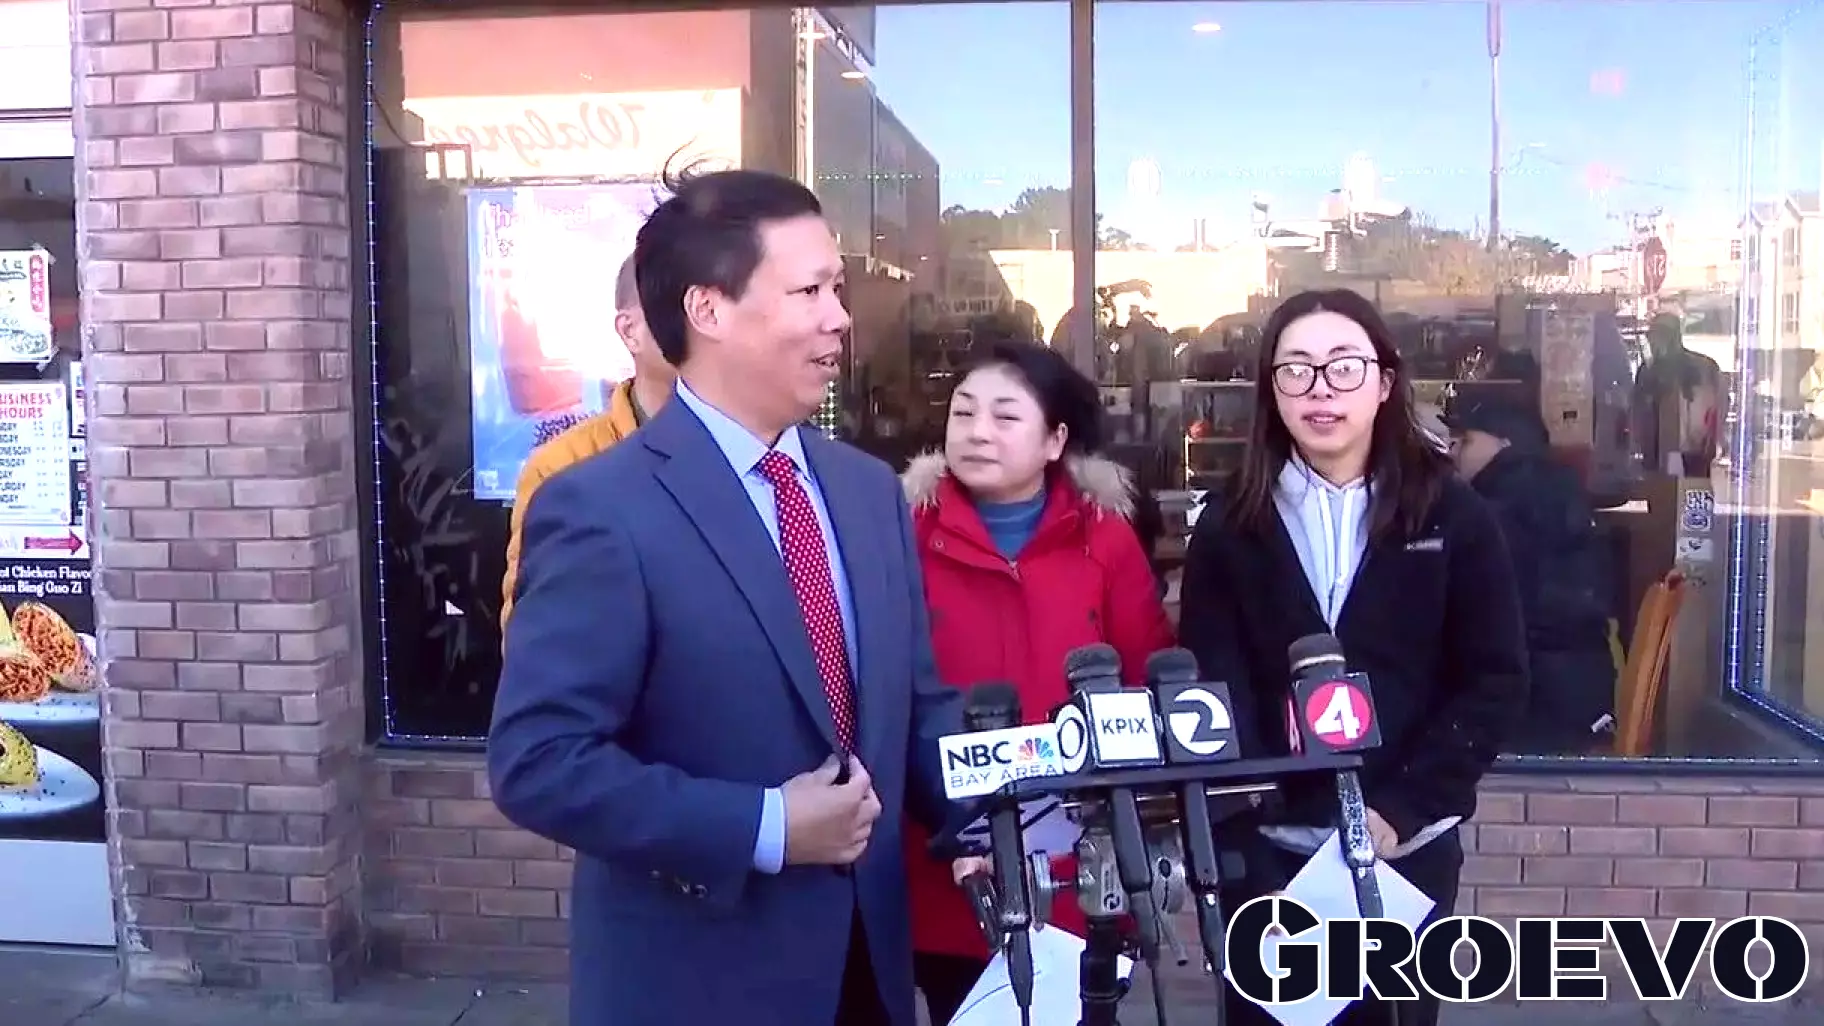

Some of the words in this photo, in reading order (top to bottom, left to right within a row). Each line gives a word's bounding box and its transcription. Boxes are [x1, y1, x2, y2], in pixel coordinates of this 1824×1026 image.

[0, 407, 43, 419] HOURS
[12, 565, 57, 578] Chicken
[17, 580, 44, 598] Bing
[45, 580, 69, 594] Guo
[1314, 685, 1360, 739] 4
[1101, 714, 1149, 736] KPIX
[947, 740, 1012, 771] NBC
[950, 770, 991, 789] BAY
[999, 763, 1058, 782] AREA
